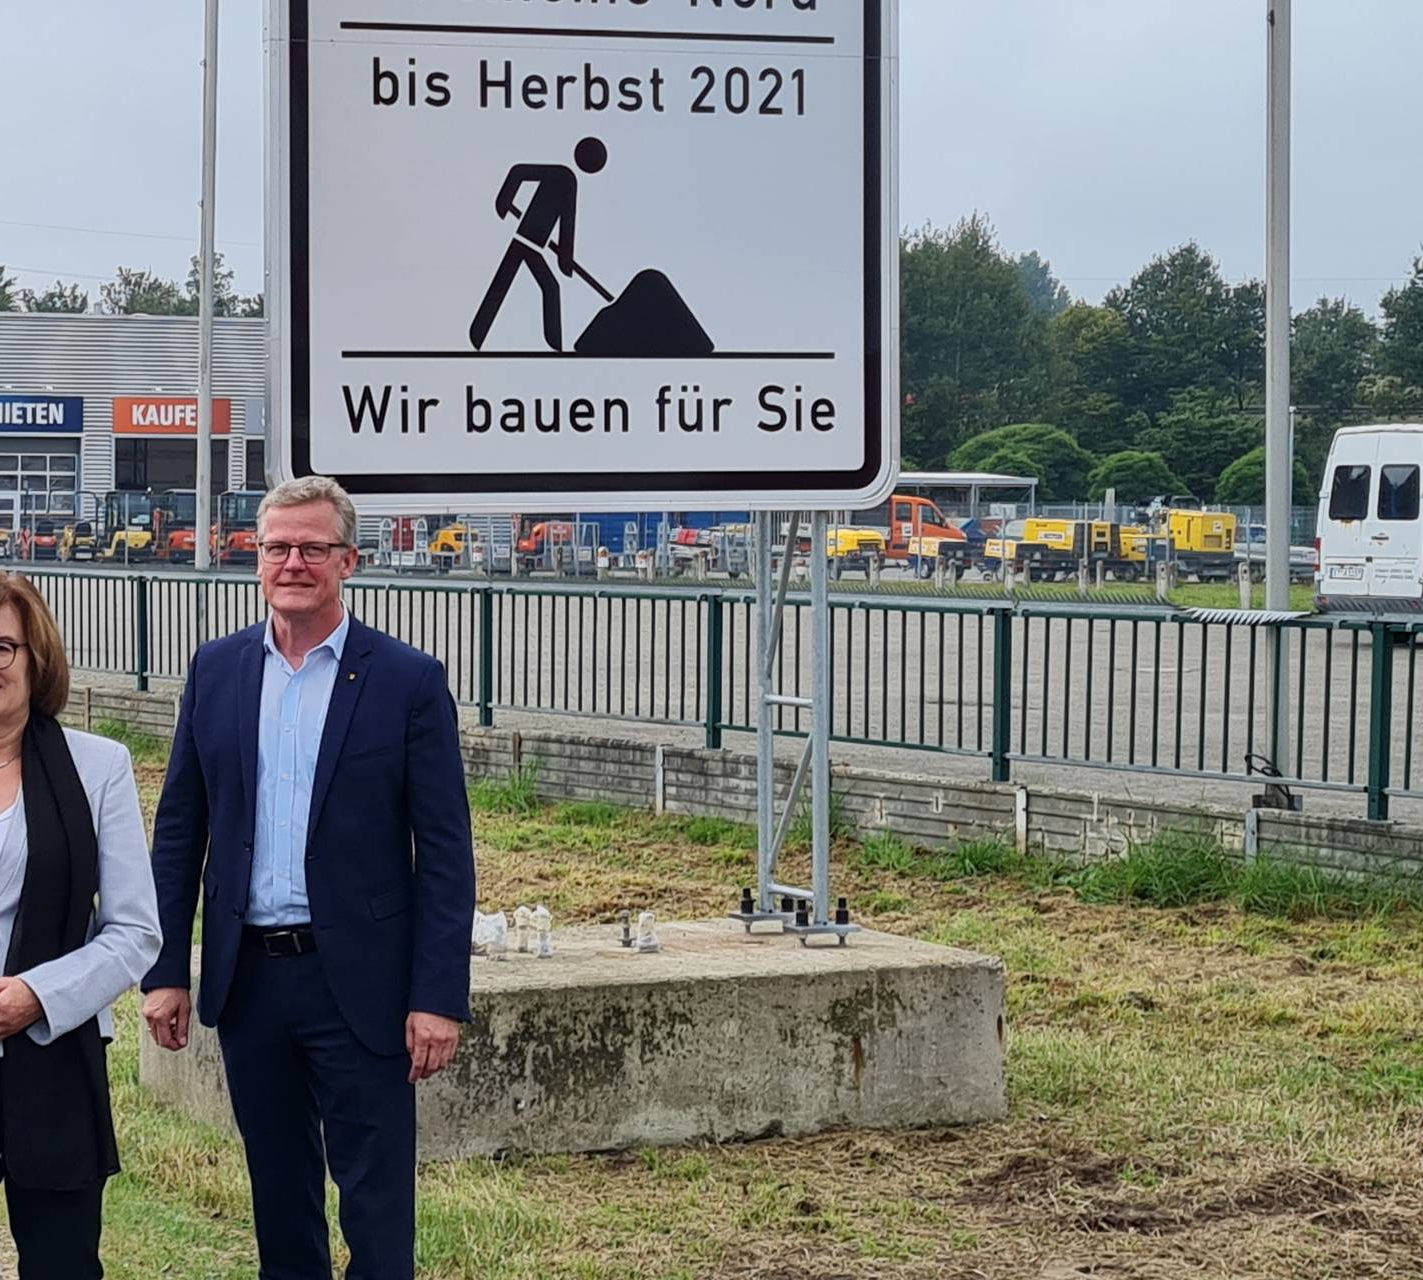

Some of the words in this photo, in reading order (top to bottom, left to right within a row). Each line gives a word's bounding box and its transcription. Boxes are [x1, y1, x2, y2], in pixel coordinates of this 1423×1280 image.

[373, 57, 452, 107] bis
[479, 60, 665, 112] Herbst
[689, 66, 805, 116] 2021
[131, 404, 197, 427] KAUFE
[342, 385, 440, 434] Wir
[466, 385, 630, 434] bauen
[656, 385, 733, 433] für
[756, 384, 836, 433] Sie
